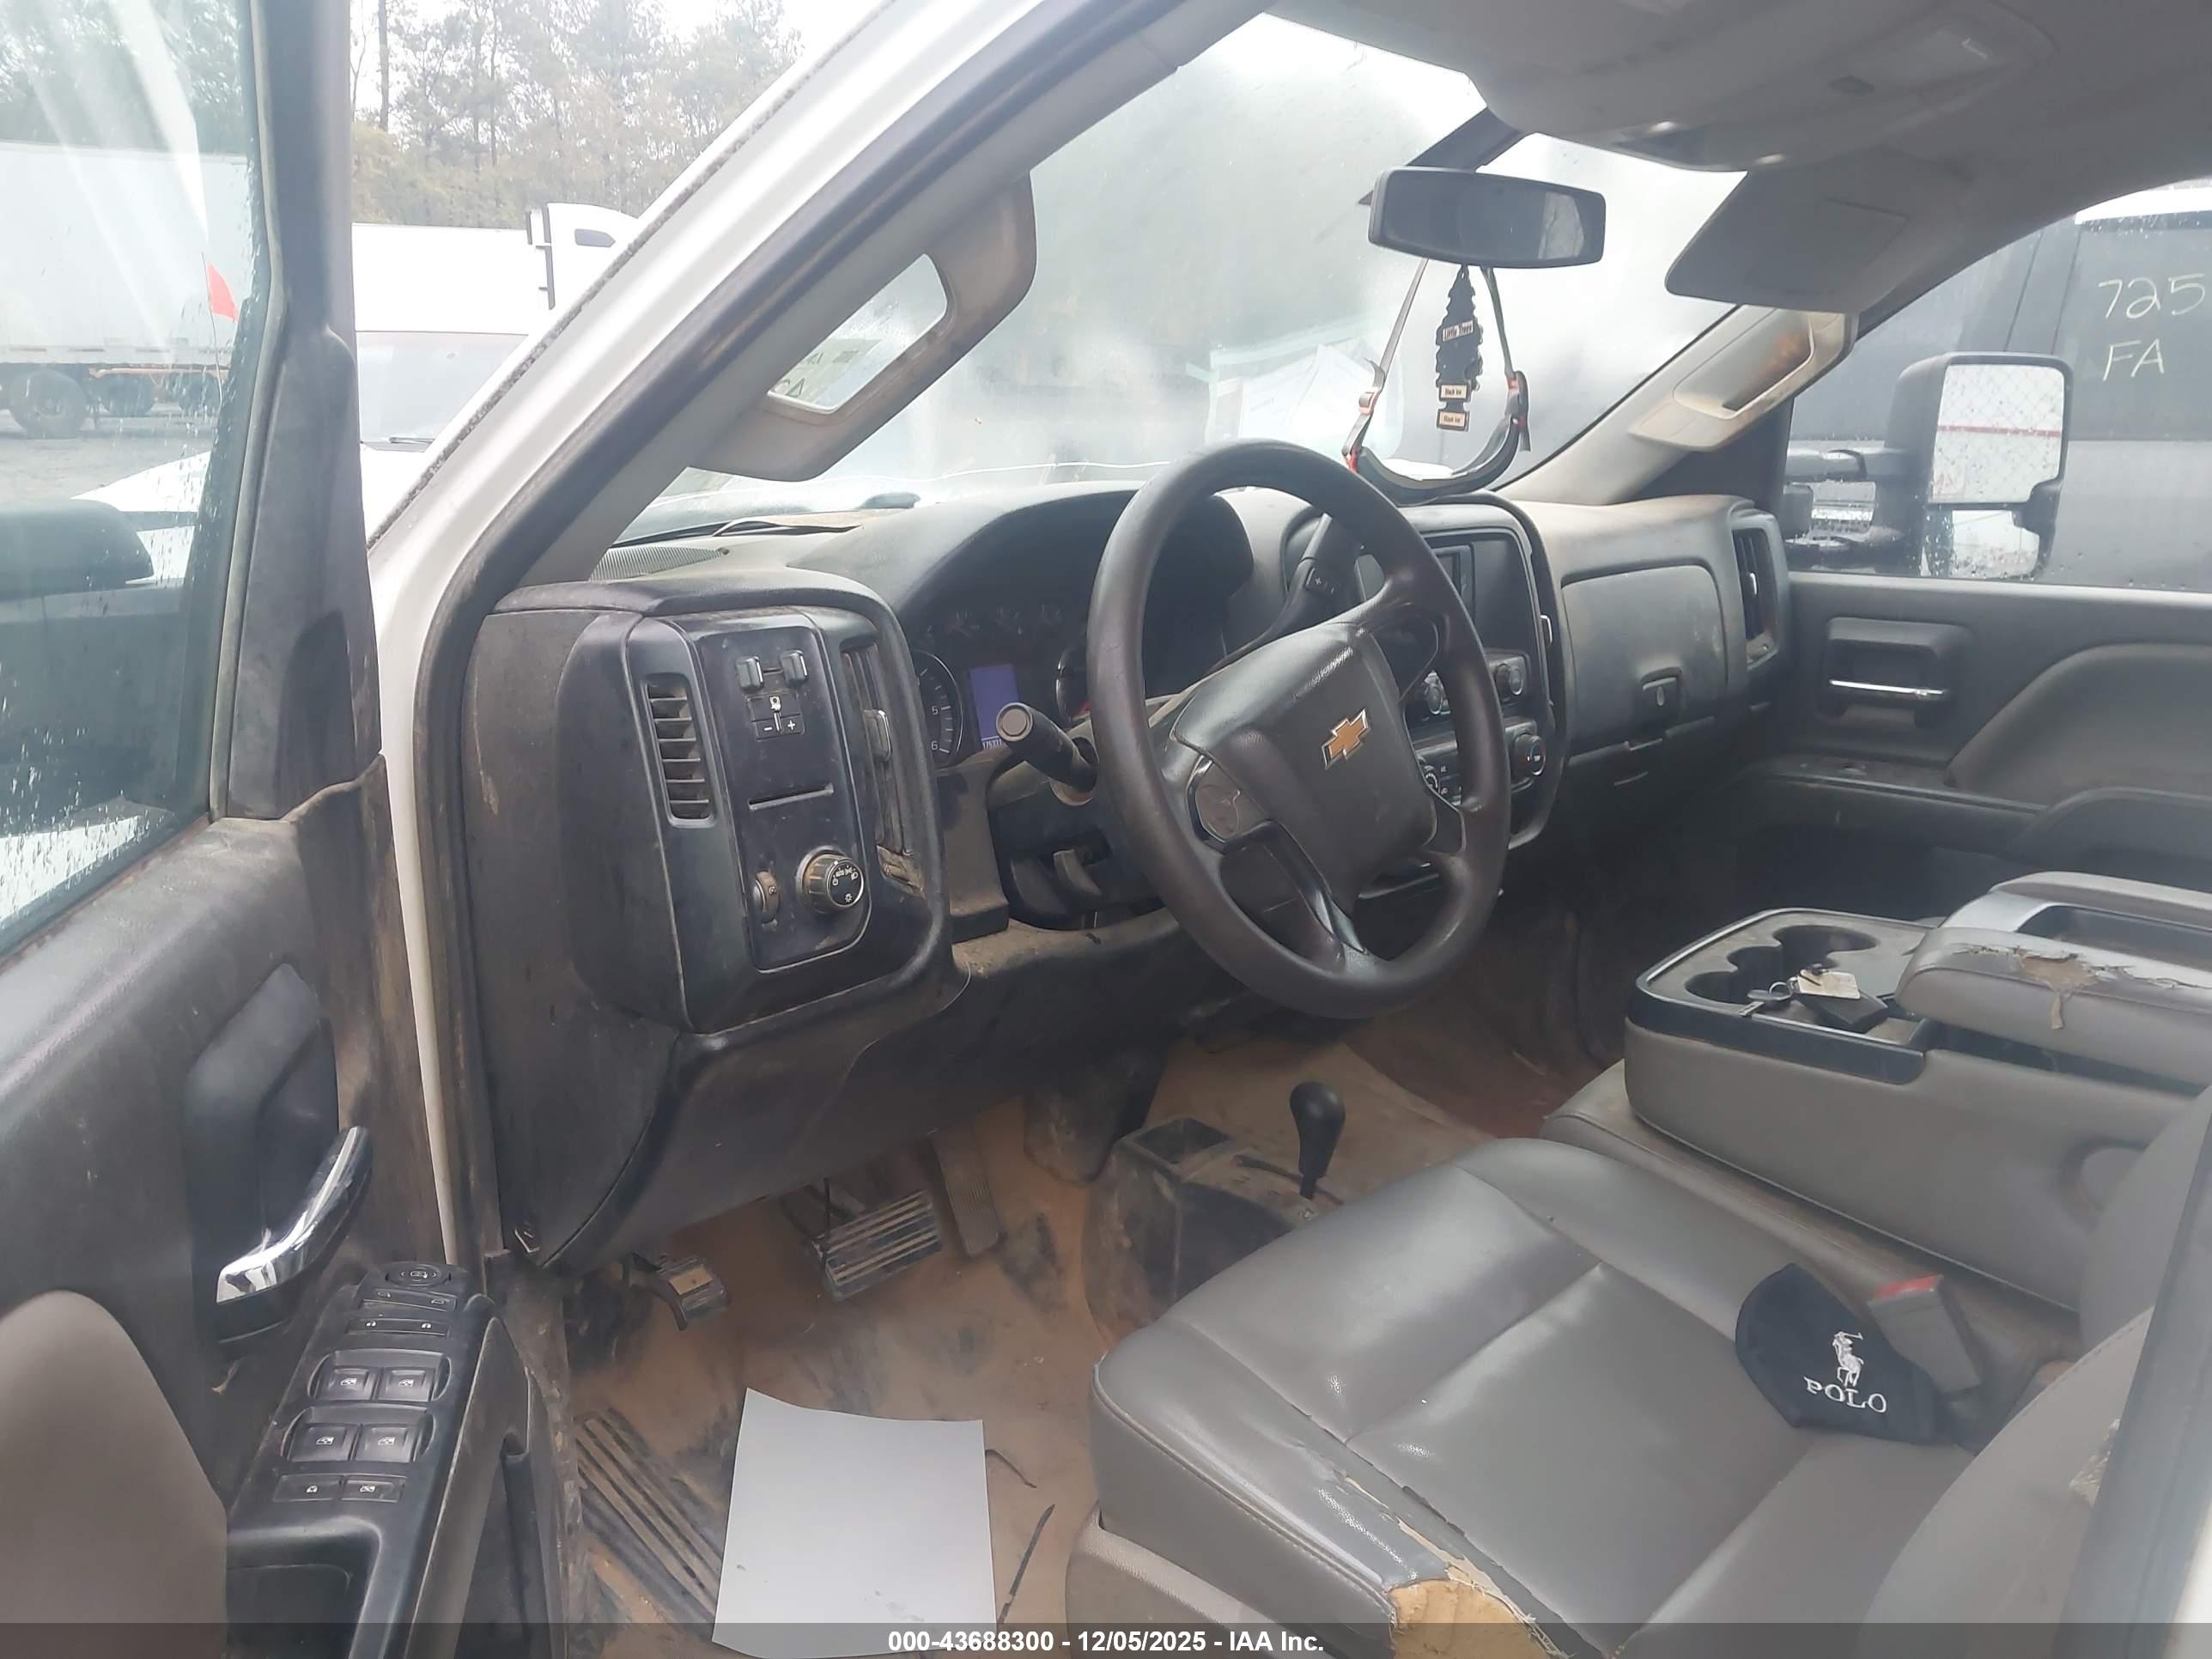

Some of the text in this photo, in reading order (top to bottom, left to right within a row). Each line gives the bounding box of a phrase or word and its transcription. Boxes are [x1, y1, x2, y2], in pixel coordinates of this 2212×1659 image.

[2098, 272, 2206, 319] 725
[2103, 338, 2165, 381] FA
[931, 706, 939, 715] 5
[931, 740, 939, 750] 6
[1803, 1376, 1887, 1413] POLO
